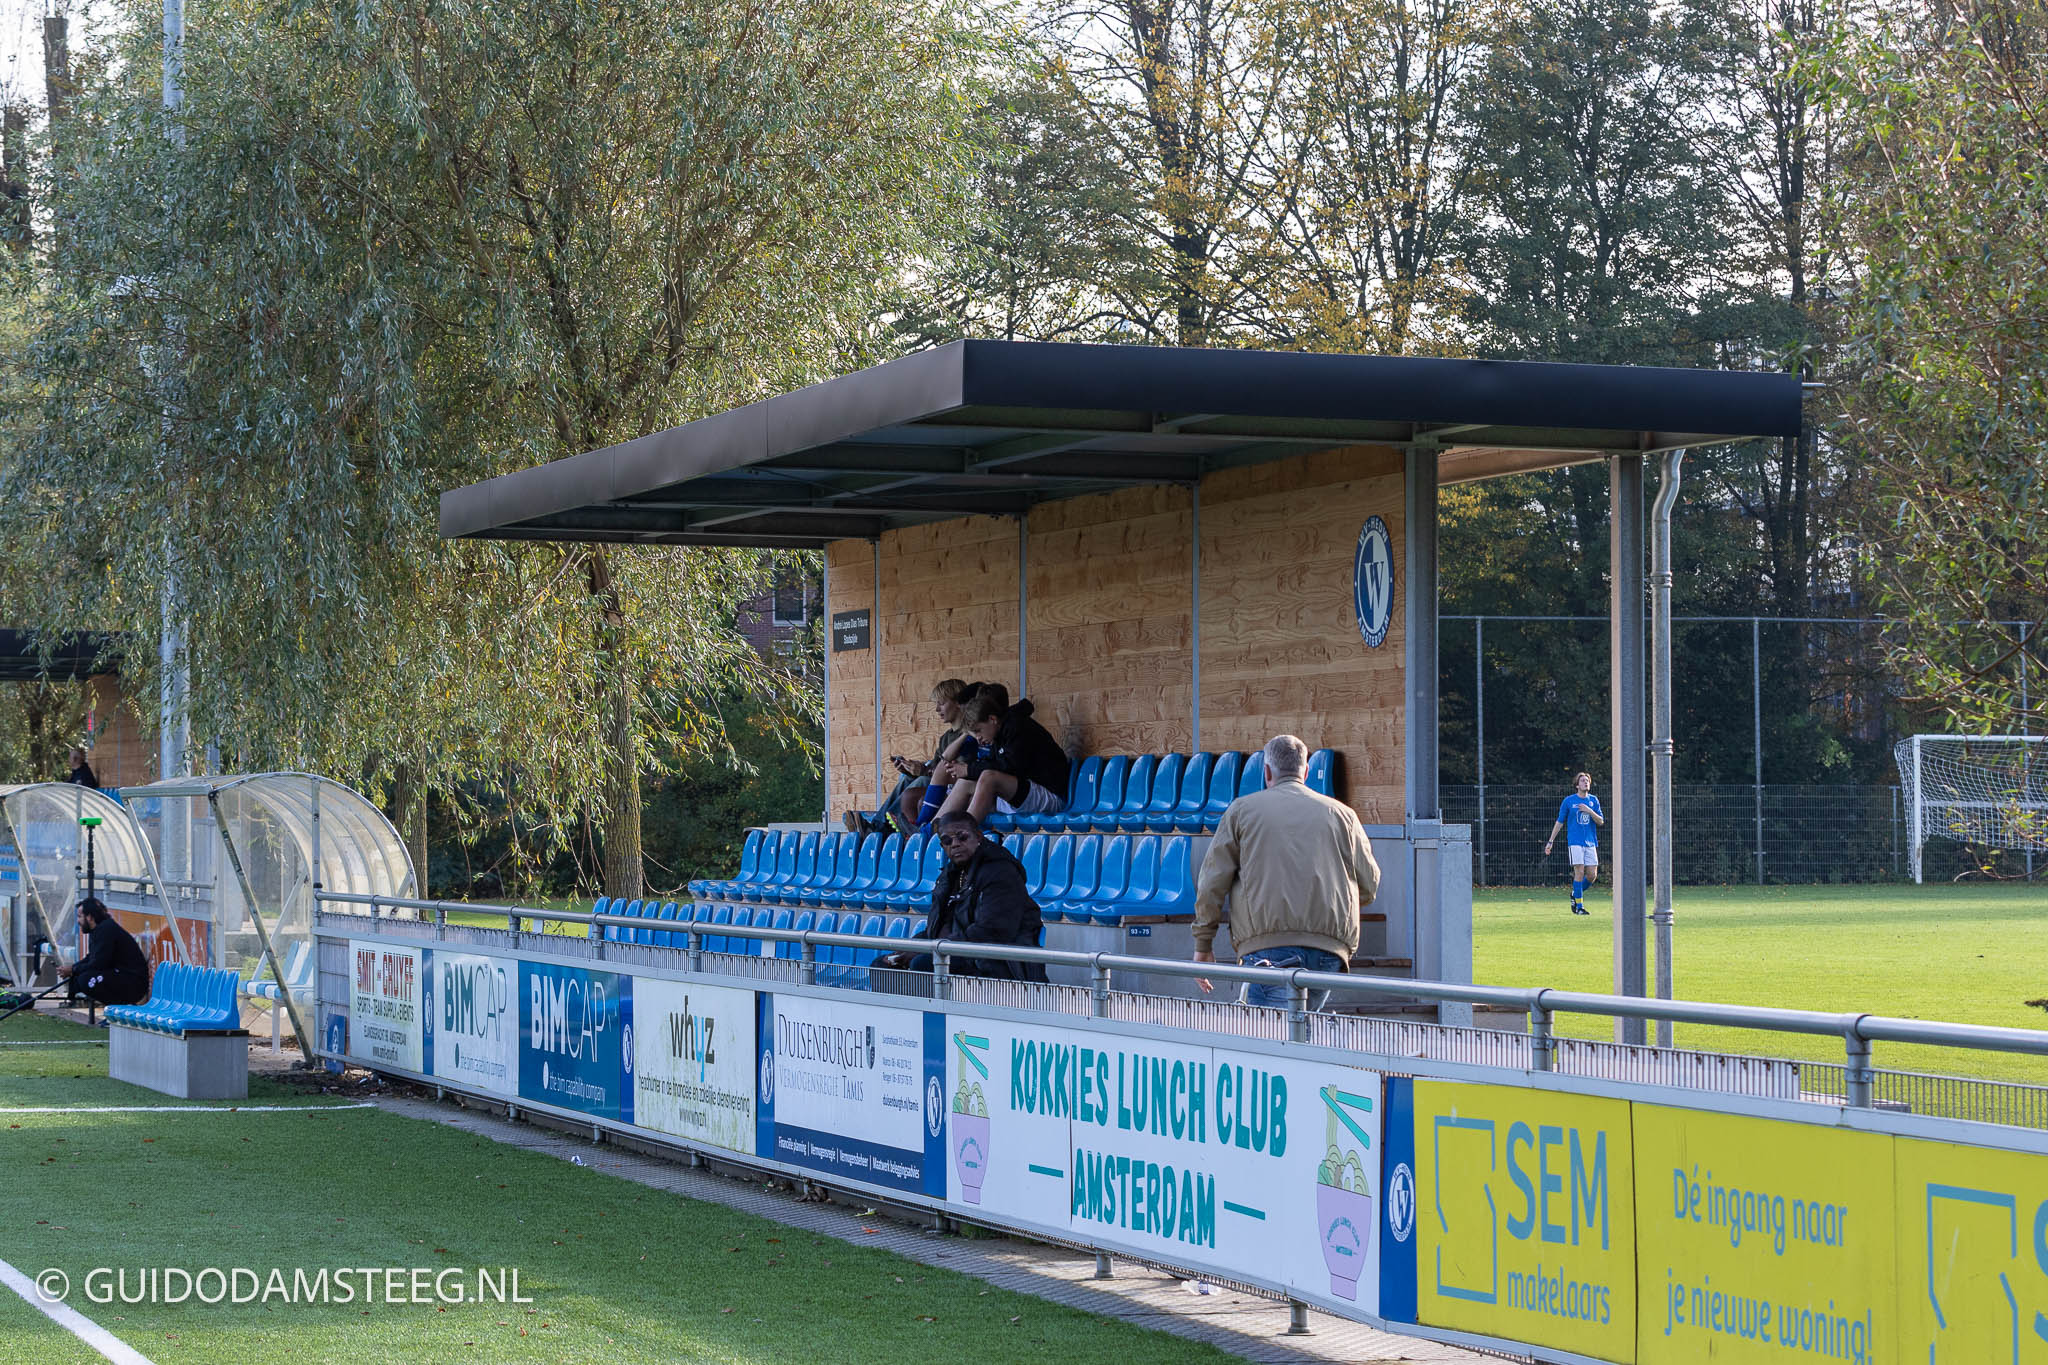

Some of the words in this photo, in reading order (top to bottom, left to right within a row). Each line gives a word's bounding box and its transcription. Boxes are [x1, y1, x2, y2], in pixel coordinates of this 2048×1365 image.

[357, 948, 376, 995] SMIT
[382, 951, 415, 1002] CRUYFF
[444, 962, 507, 1042] BIMCAP
[530, 973, 606, 1063] BIMCAP
[669, 995, 715, 1083] whyz
[778, 1013, 864, 1070] DUISENBURGH
[778, 1064, 839, 1097] VERMOGENSREGIE
[842, 1075, 865, 1102] TAMIS
[1010, 1037, 1109, 1127] KOKKIES
[1117, 1051, 1207, 1144] LUNCH
[1215, 1062, 1288, 1158] CLUB
[1072, 1148, 1216, 1249] AMSTERDAM
[1505, 1121, 1610, 1251] SEM
[1673, 1163, 1702, 1222] Dé
[1707, 1169, 1786, 1256] ingang
[1792, 1198, 1849, 1247] naar
[1507, 1263, 1611, 1325] makelaars
[1664, 1267, 1686, 1337] je
[1691, 1274, 1772, 1343] nieuwe
[1778, 1299, 1874, 1365] woning!
